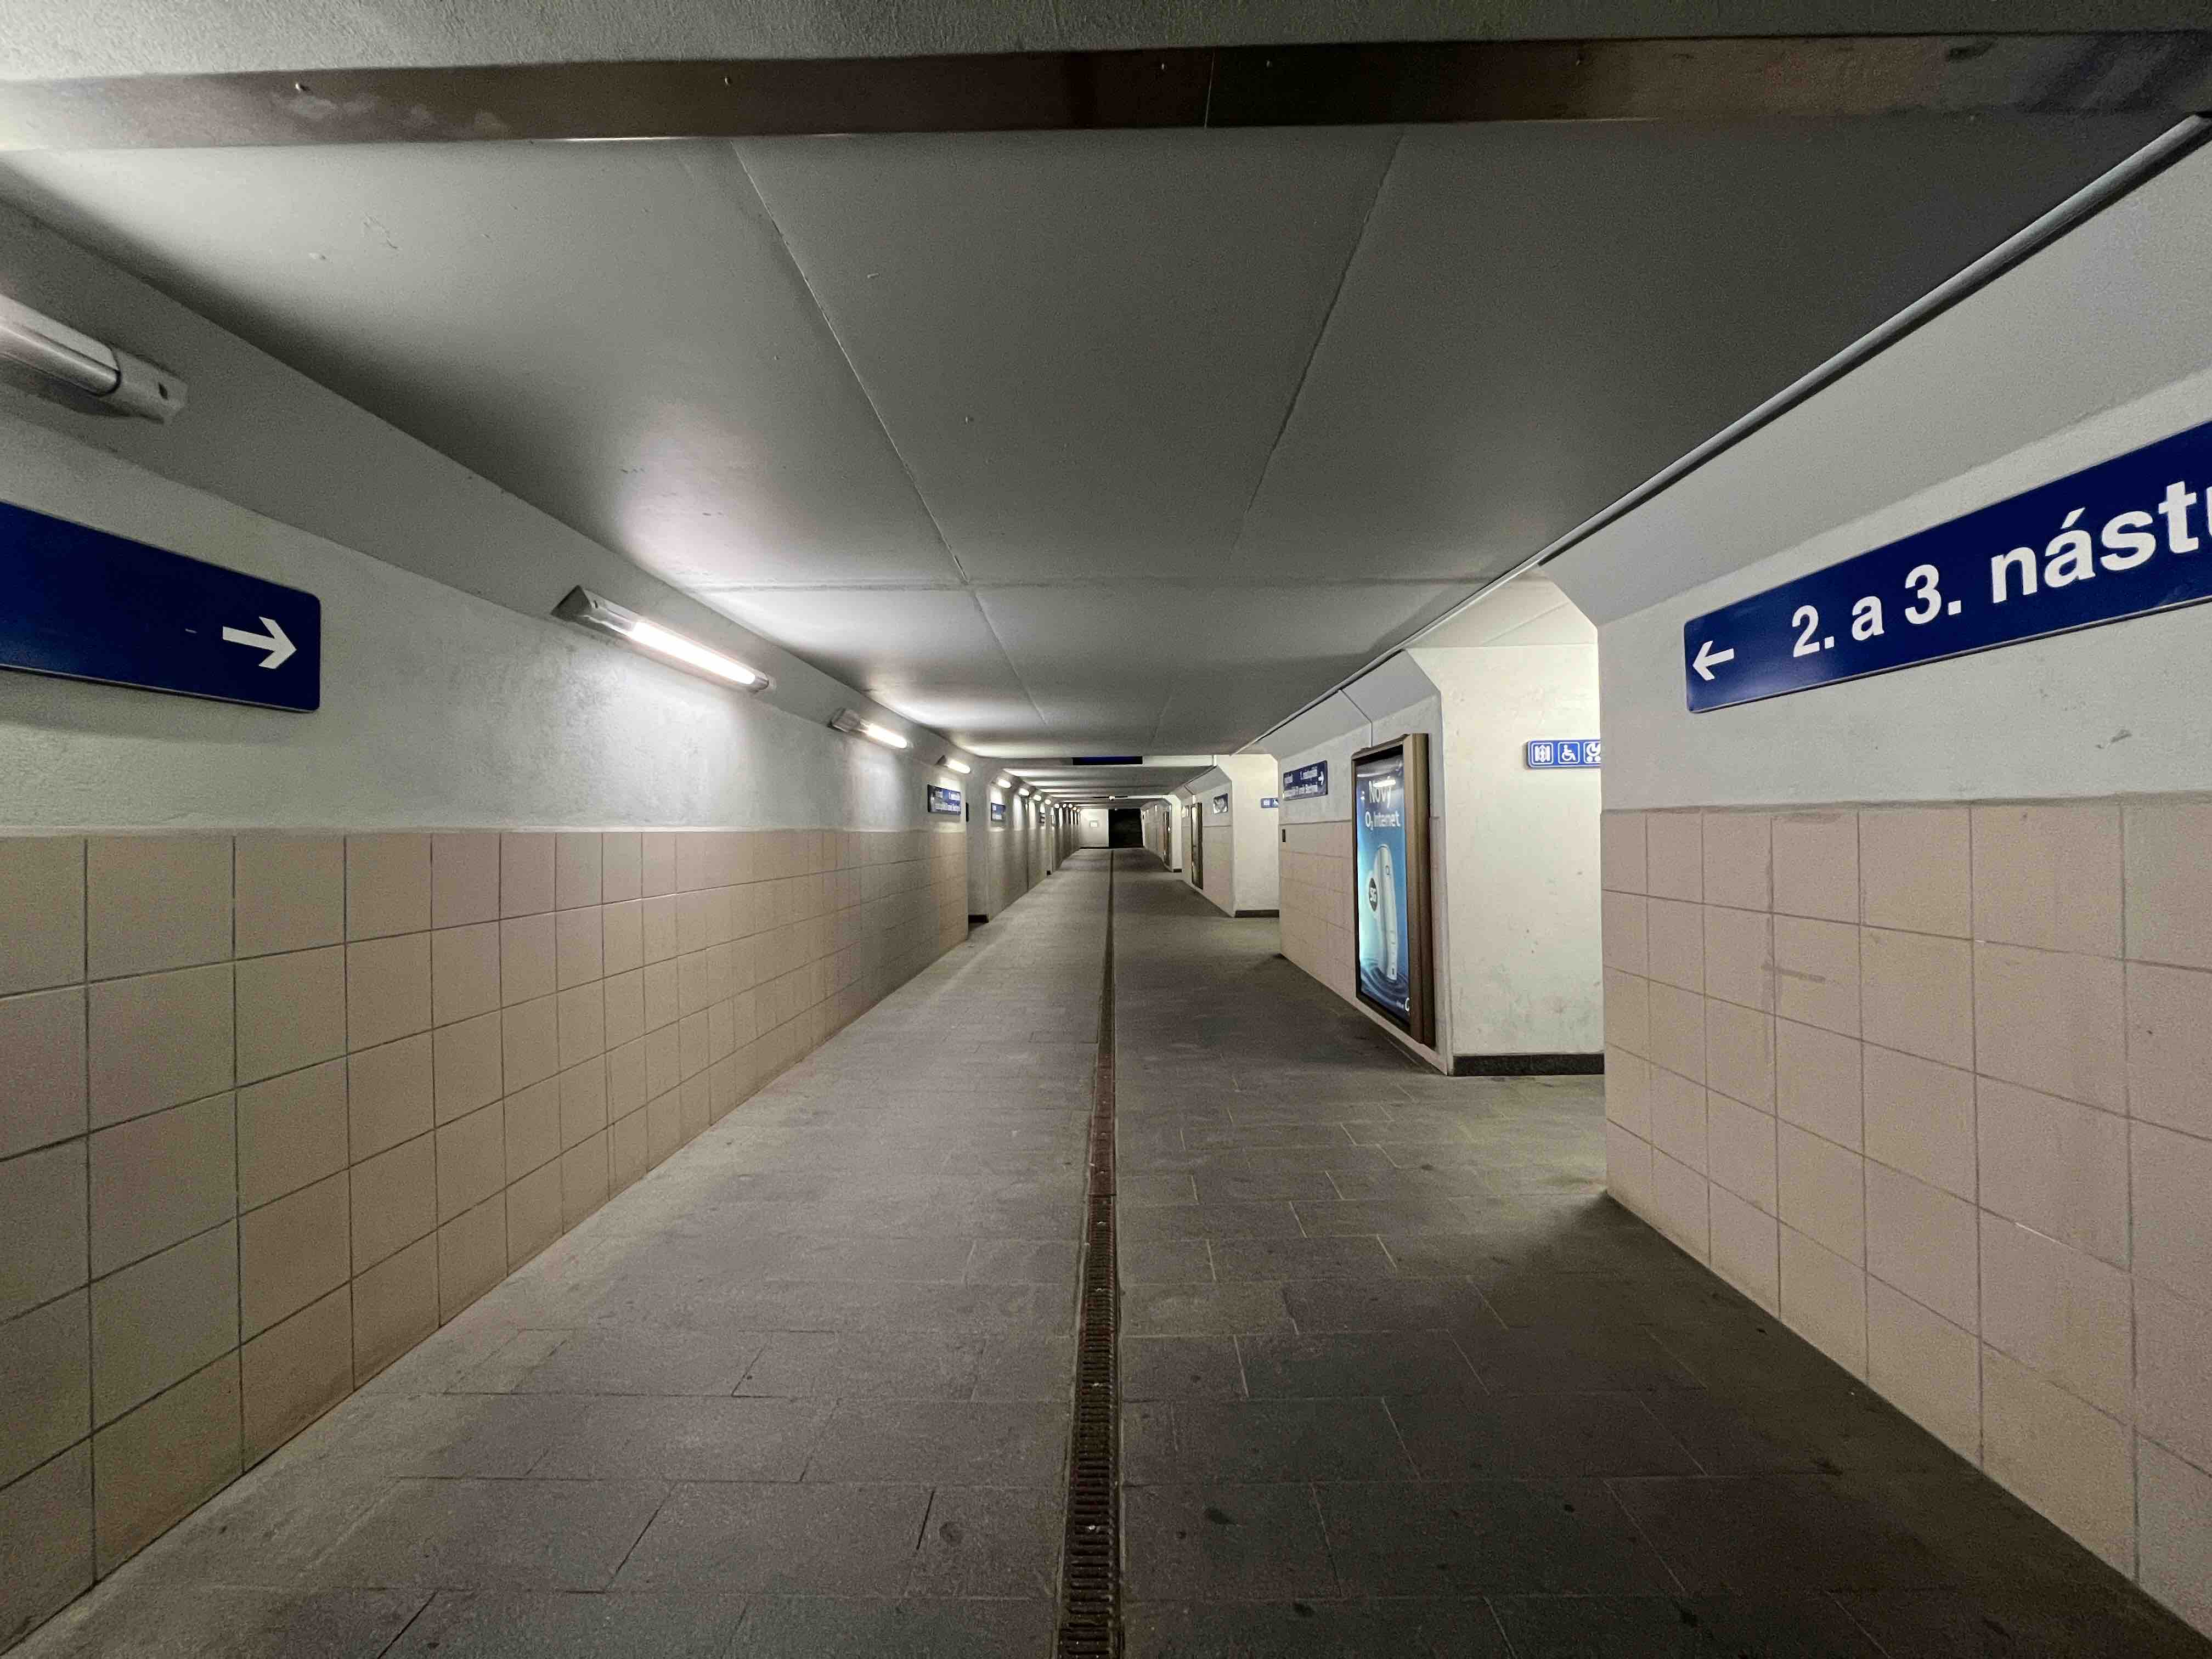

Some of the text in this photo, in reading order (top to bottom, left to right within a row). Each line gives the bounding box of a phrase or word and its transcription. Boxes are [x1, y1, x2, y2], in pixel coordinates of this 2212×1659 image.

[1792, 481, 2212, 657] 2. a 3. nást
